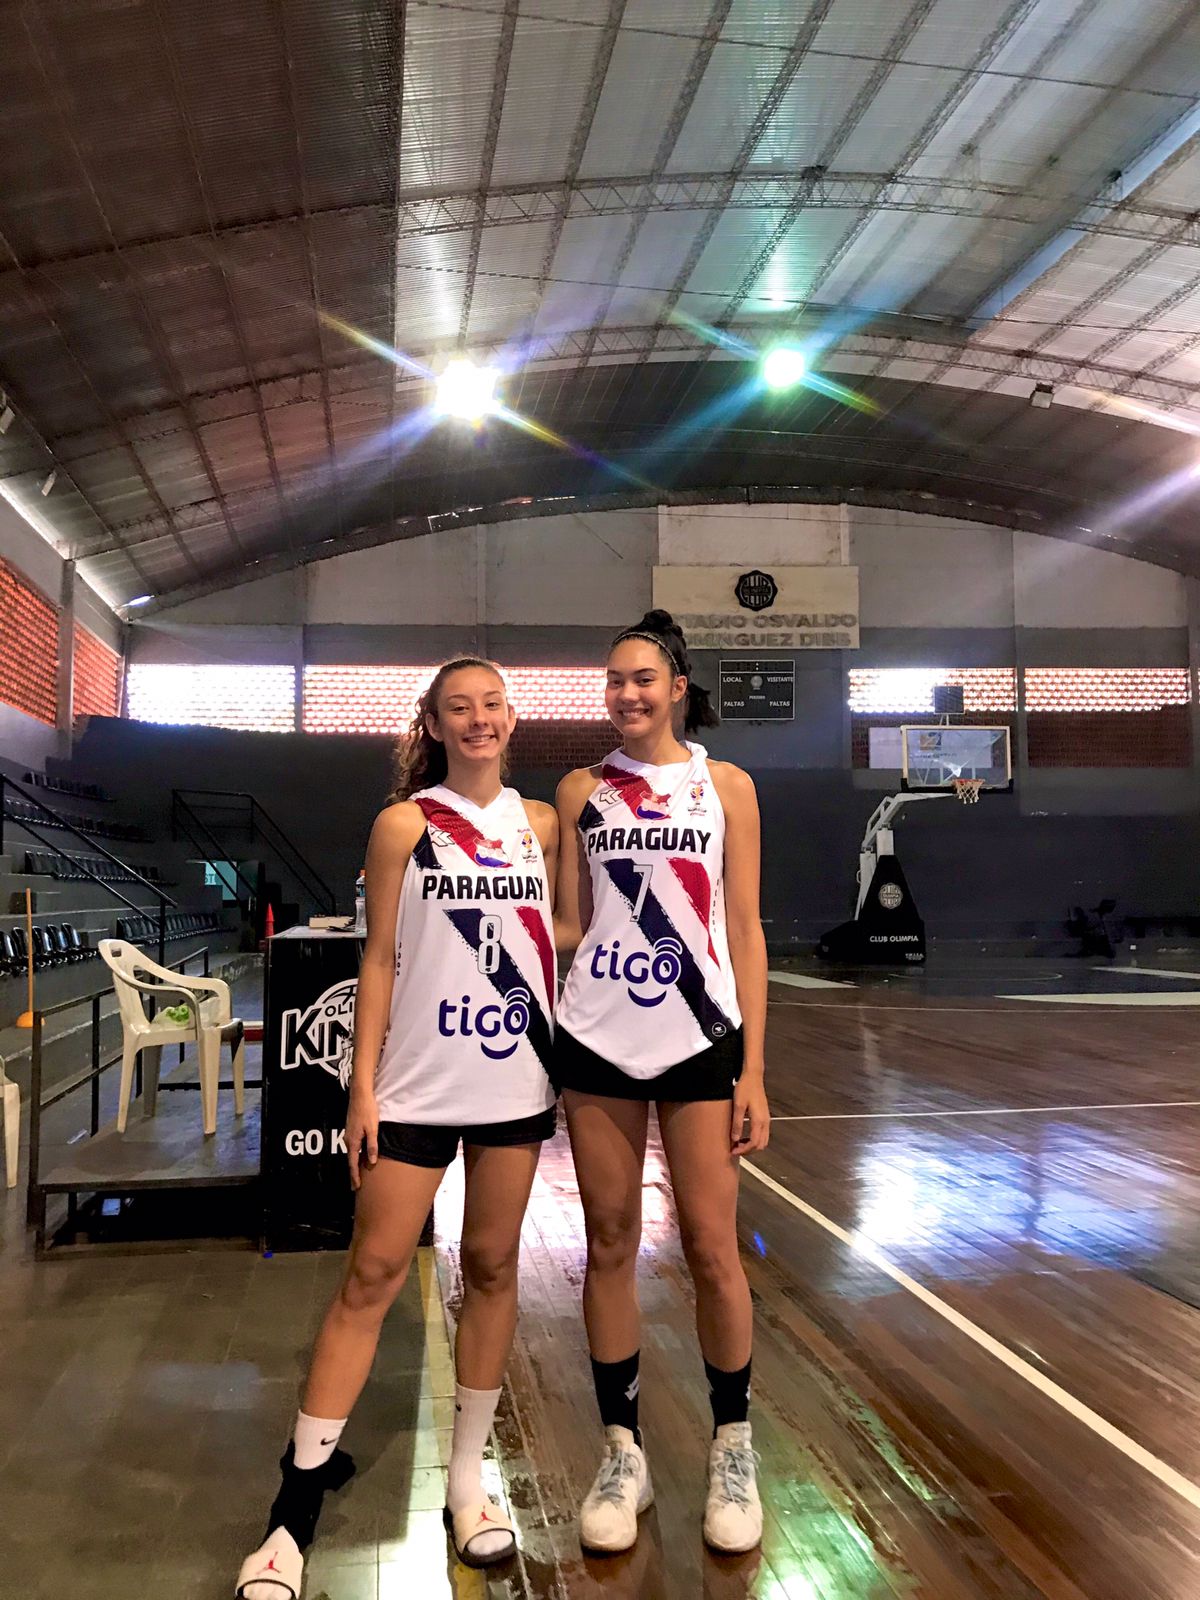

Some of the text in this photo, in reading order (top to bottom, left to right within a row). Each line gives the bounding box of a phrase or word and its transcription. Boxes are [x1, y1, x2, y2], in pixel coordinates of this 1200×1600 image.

[752, 613, 857, 629] OSVALDO
[800, 632, 850, 647] DIBB
[587, 827, 711, 857] PARAGUAY
[422, 875, 543, 901] PARAGUAY
[630, 864, 653, 923] 7
[477, 914, 502, 975] 8
[285, 1128, 349, 1156] GO K
